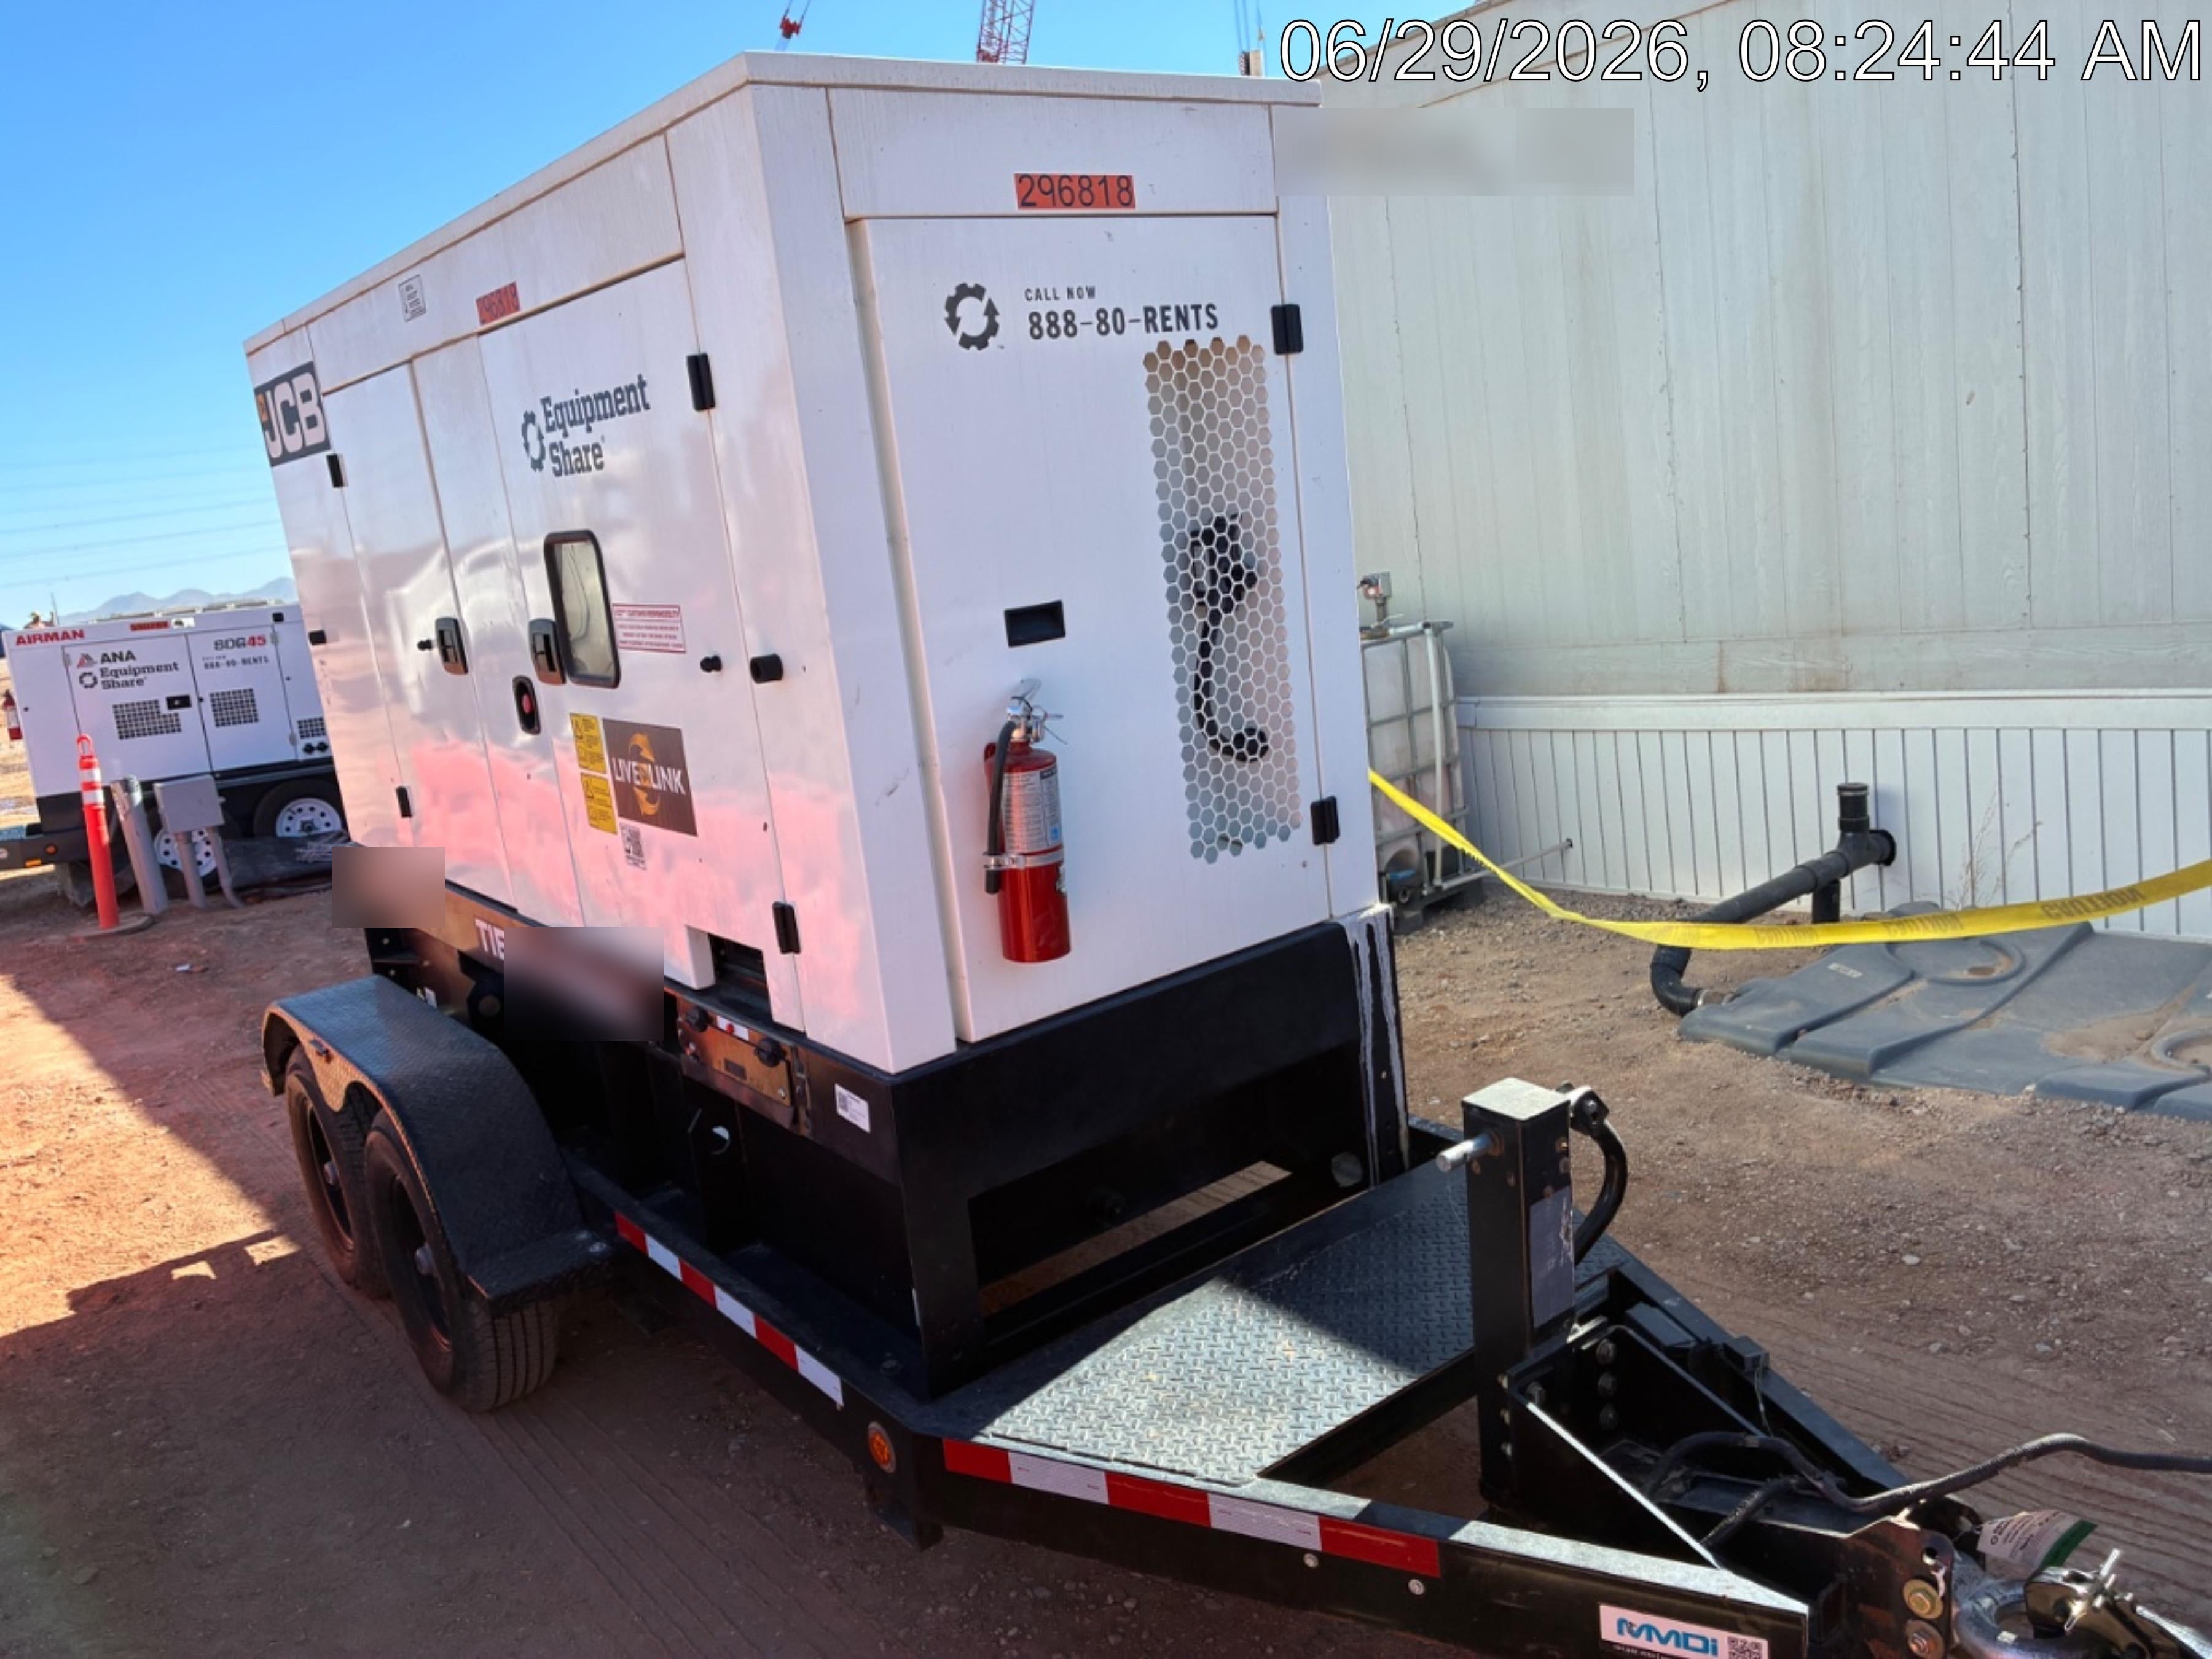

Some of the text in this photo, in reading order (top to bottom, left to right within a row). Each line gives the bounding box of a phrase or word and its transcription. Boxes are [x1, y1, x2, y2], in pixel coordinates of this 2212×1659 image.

[1017, 175, 1134, 208] 296818
[1024, 285, 1096, 301] CALL NOW
[1028, 303, 1218, 340] 888-80-RENTS
[264, 372, 326, 458] JCB
[540, 374, 651, 439] Equipment
[549, 441, 605, 477] Share
[16, 629, 85, 645] AIRMAN
[101, 650, 136, 664] ANA
[100, 661, 179, 679] Equipment
[101, 675, 144, 689] Share
